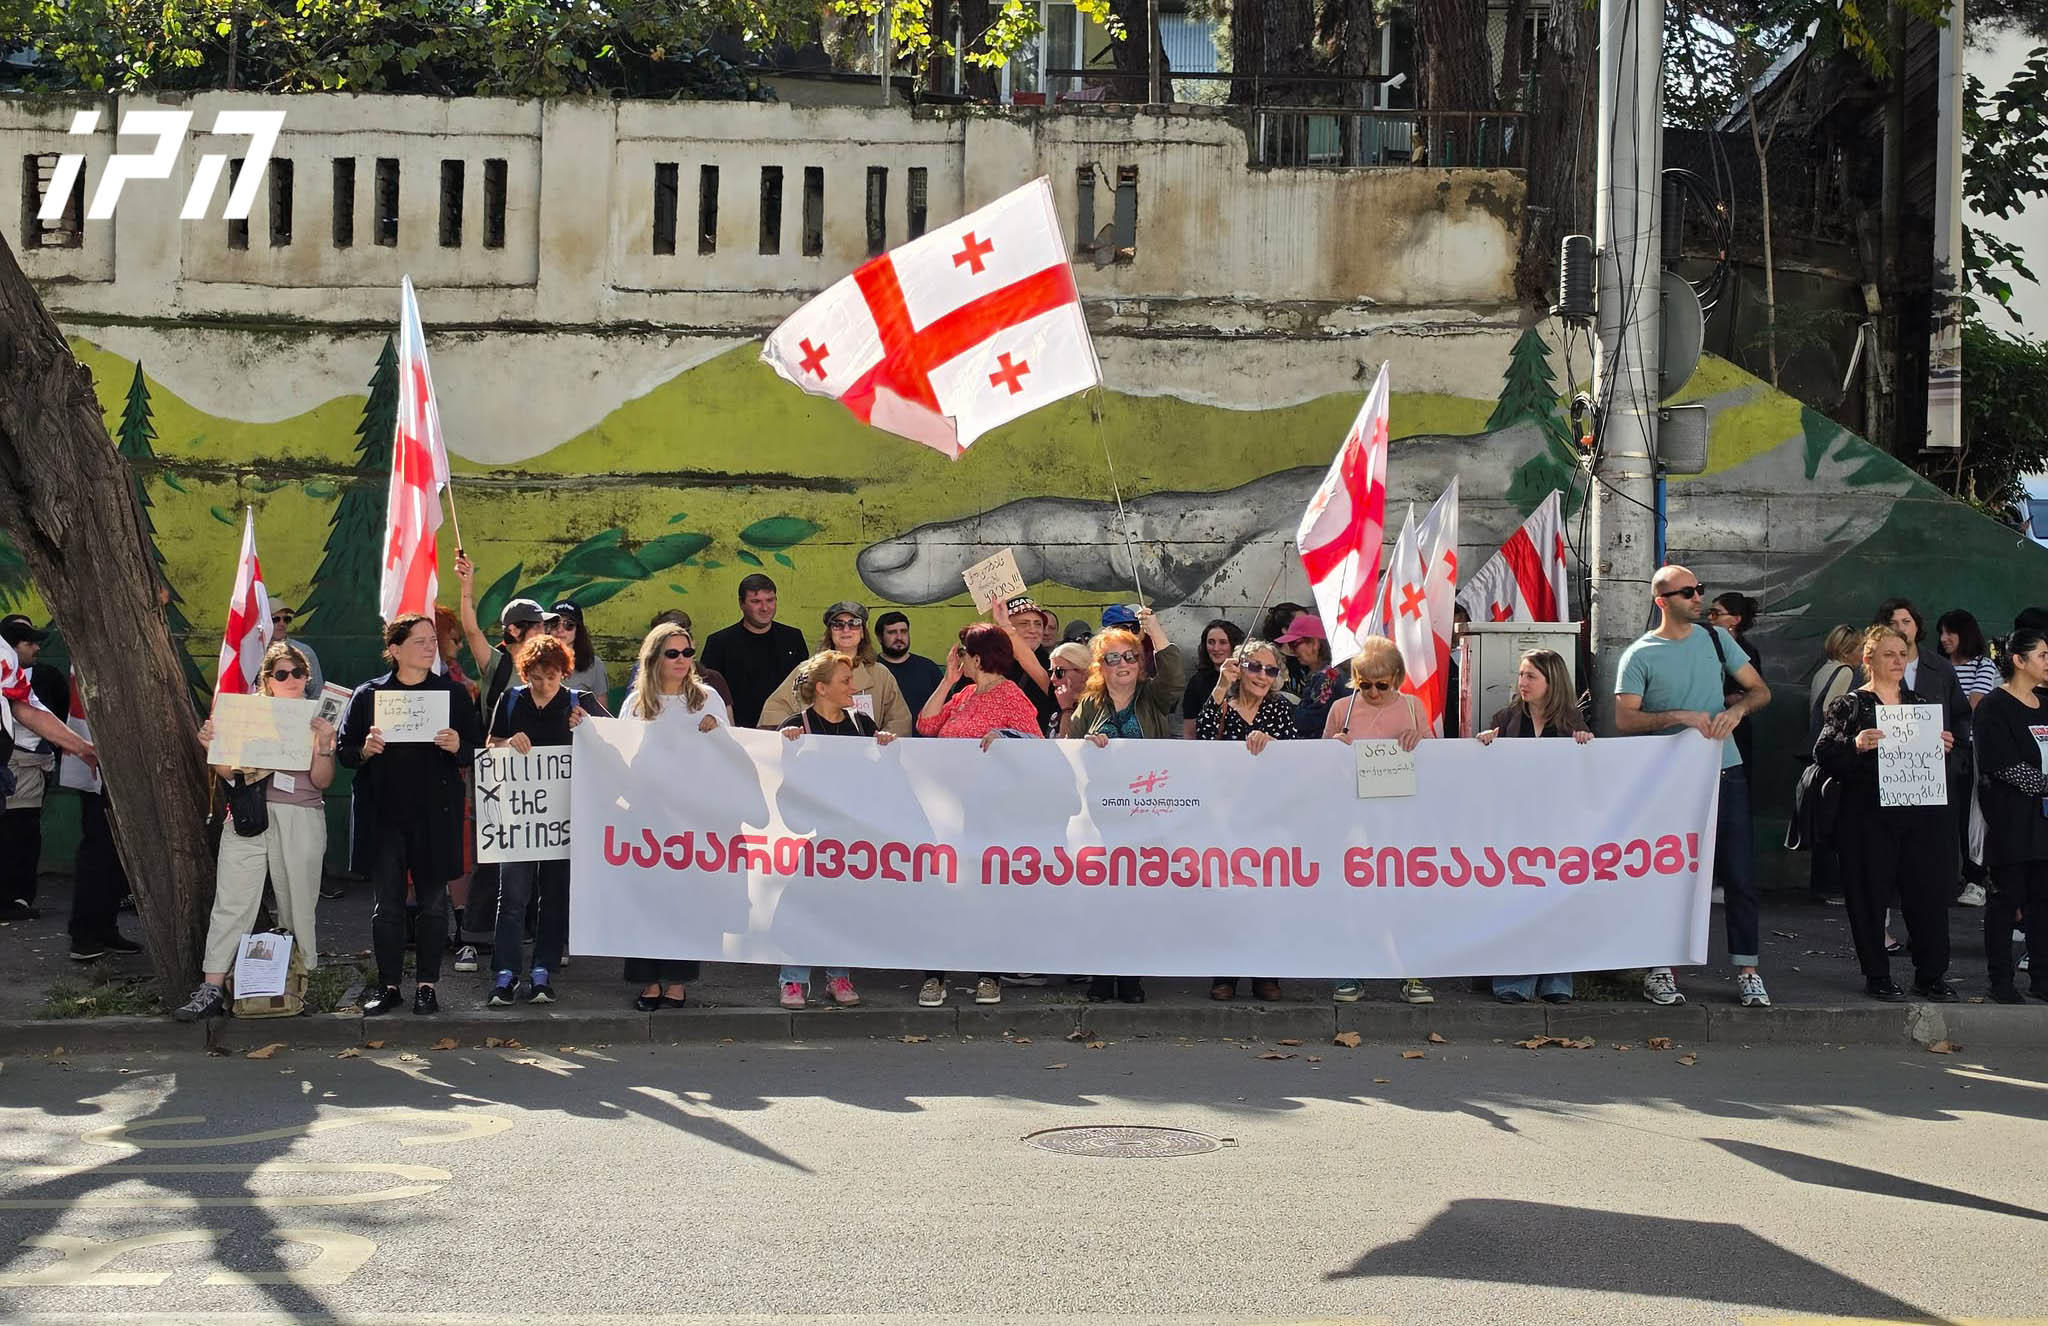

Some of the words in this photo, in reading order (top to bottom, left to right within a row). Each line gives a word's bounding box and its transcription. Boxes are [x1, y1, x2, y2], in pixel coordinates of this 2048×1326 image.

[1009, 599, 1027, 608] USA
[1892, 722, 1915, 743] შენ
[1365, 744, 1398, 758] არა
[509, 789, 548, 815] the
[1102, 798, 1130, 807] ერთი
[1134, 798, 1200, 807] საქართველო
[603, 825, 957, 884] საქართველო
[981, 845, 1320, 888] ივანიშვილის
[1344, 832, 1699, 888] წინააღმდეგ!
